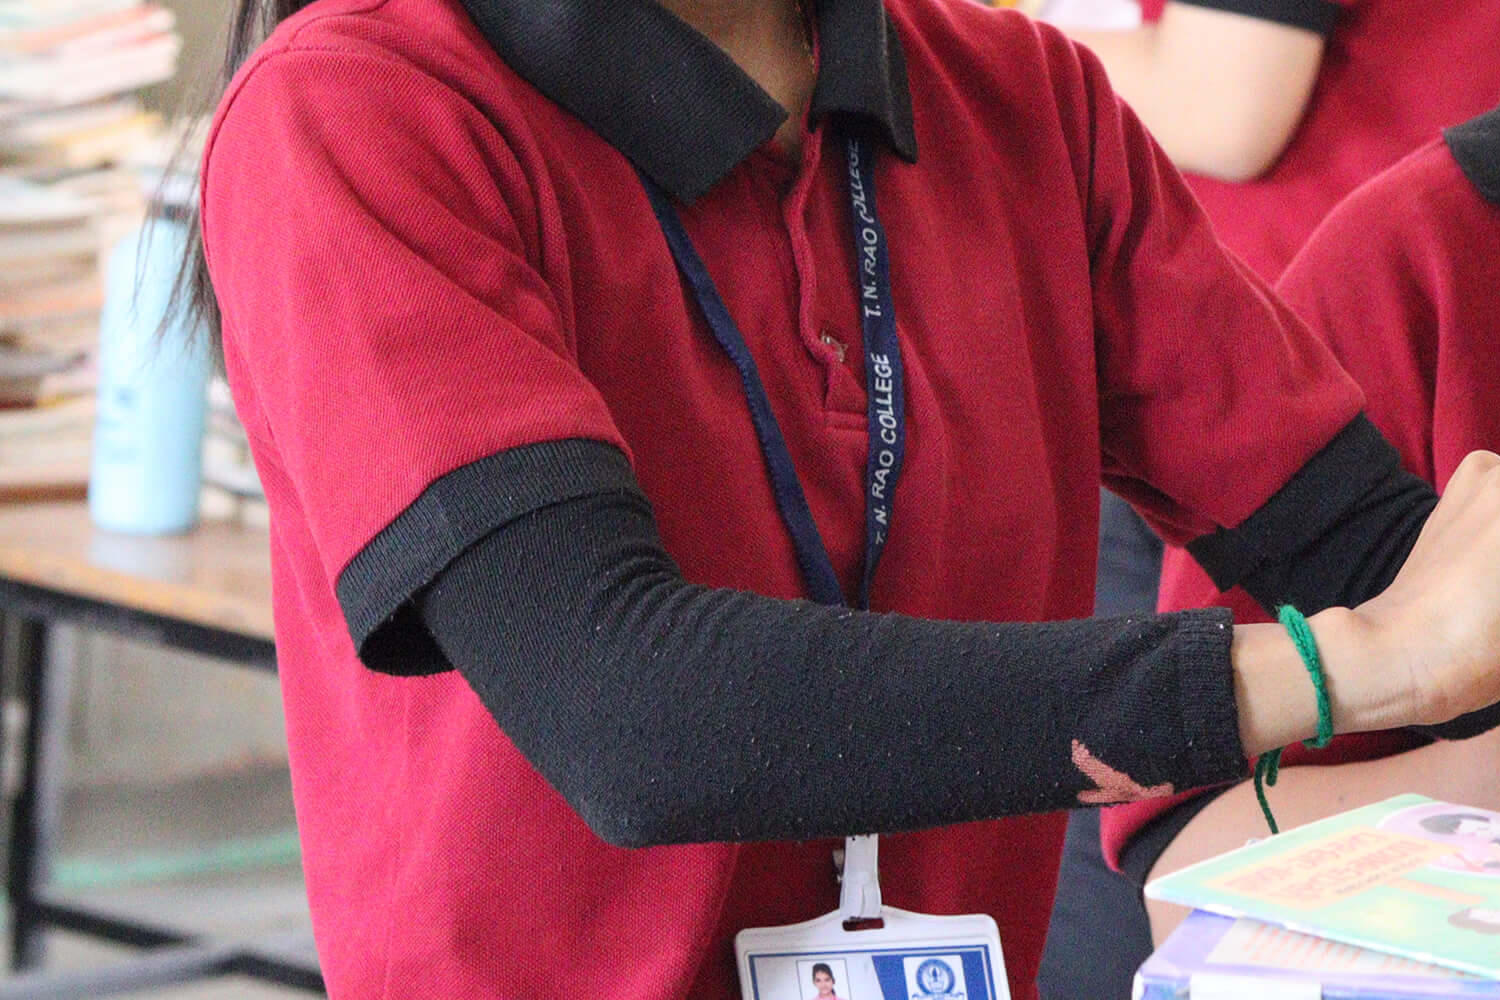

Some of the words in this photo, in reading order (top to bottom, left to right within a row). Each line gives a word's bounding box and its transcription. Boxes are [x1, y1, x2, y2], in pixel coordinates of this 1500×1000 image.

[862, 228, 877, 275] RAO
[863, 282, 878, 300] N.
[864, 305, 881, 317] T.
[870, 352, 896, 444] COLLEGE
[872, 450, 894, 499] RAO
[873, 505, 887, 525] N.
